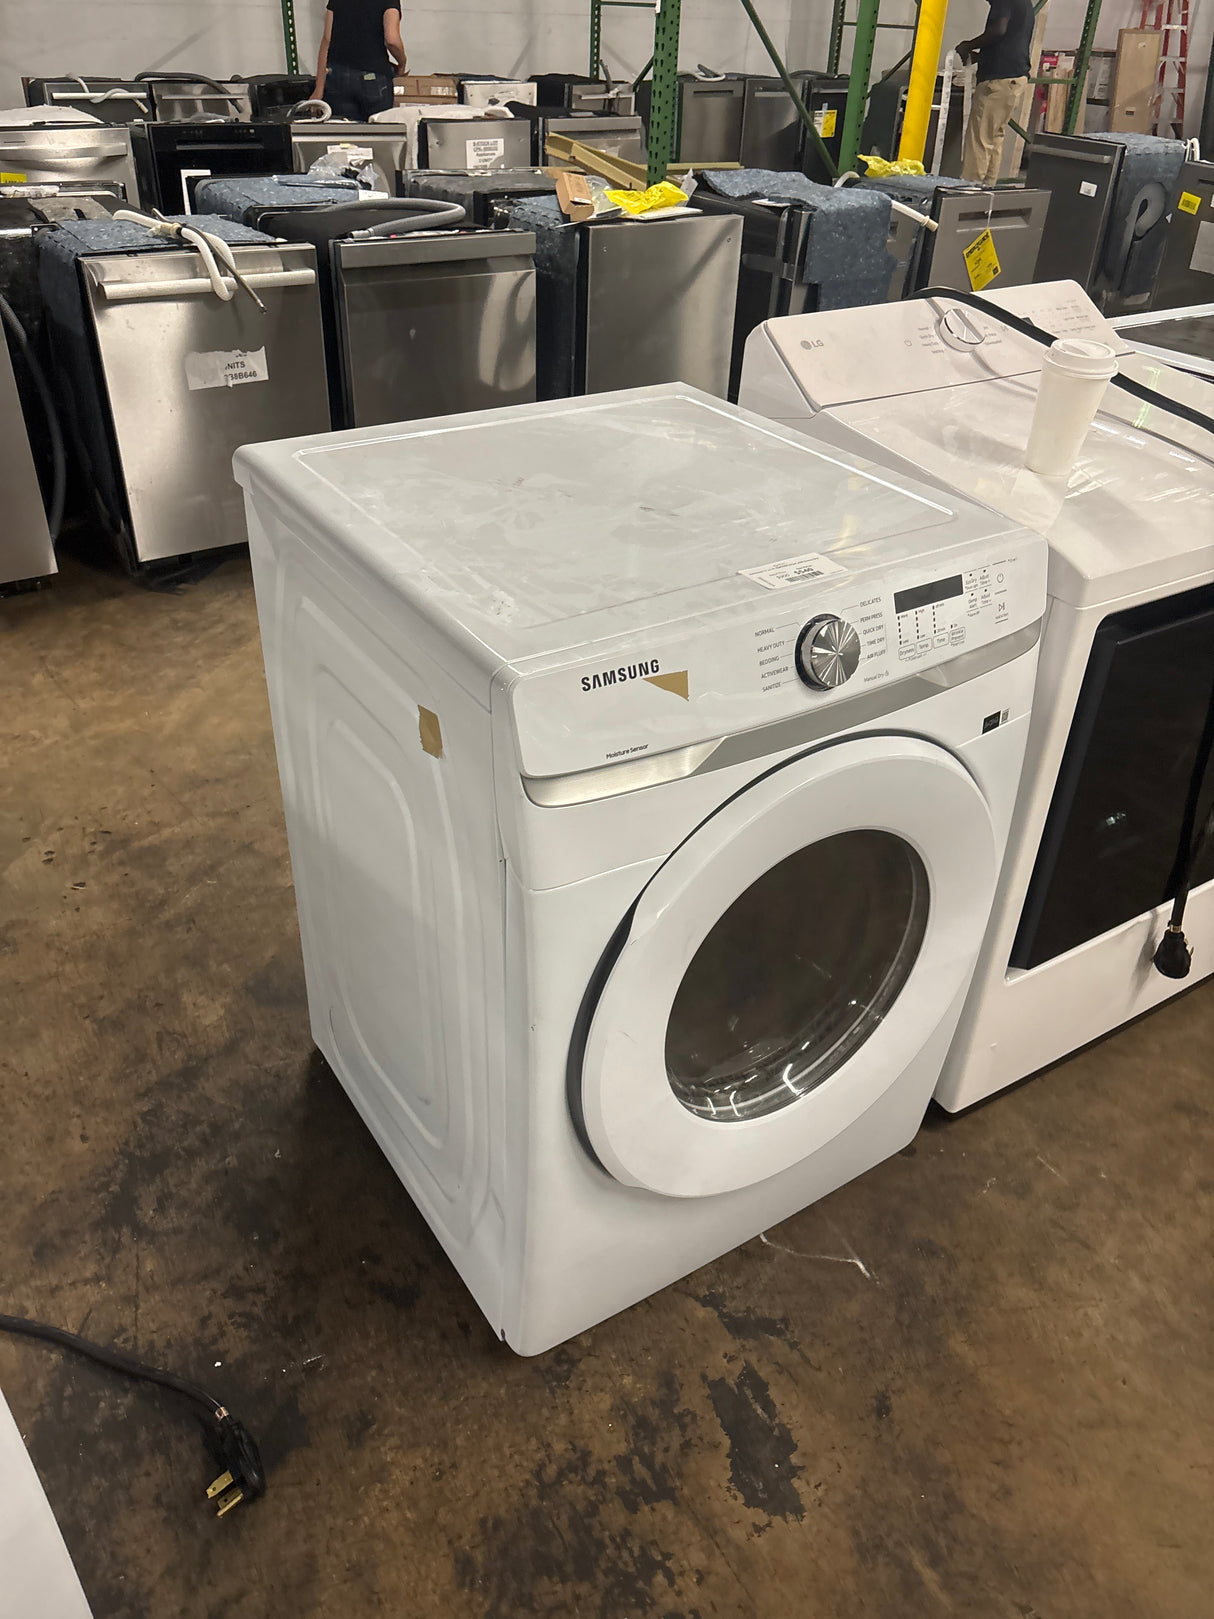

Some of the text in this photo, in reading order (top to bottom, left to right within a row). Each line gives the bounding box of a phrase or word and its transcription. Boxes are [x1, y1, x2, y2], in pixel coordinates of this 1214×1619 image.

[810, 339, 824, 348] LG
[860, 597, 882, 607] DELICATES
[860, 615, 870, 623] PERM
[754, 628, 775, 637] NORMAL
[757, 640, 785, 653] HEAVY DUTY
[759, 656, 779, 666] BEDDING
[581, 659, 660, 692] SAMSUNG
[761, 666, 789, 679] ACTIVEWEAR
[762, 682, 781, 692] SANITIZE
[606, 744, 649, 759] Moisture Sensor
